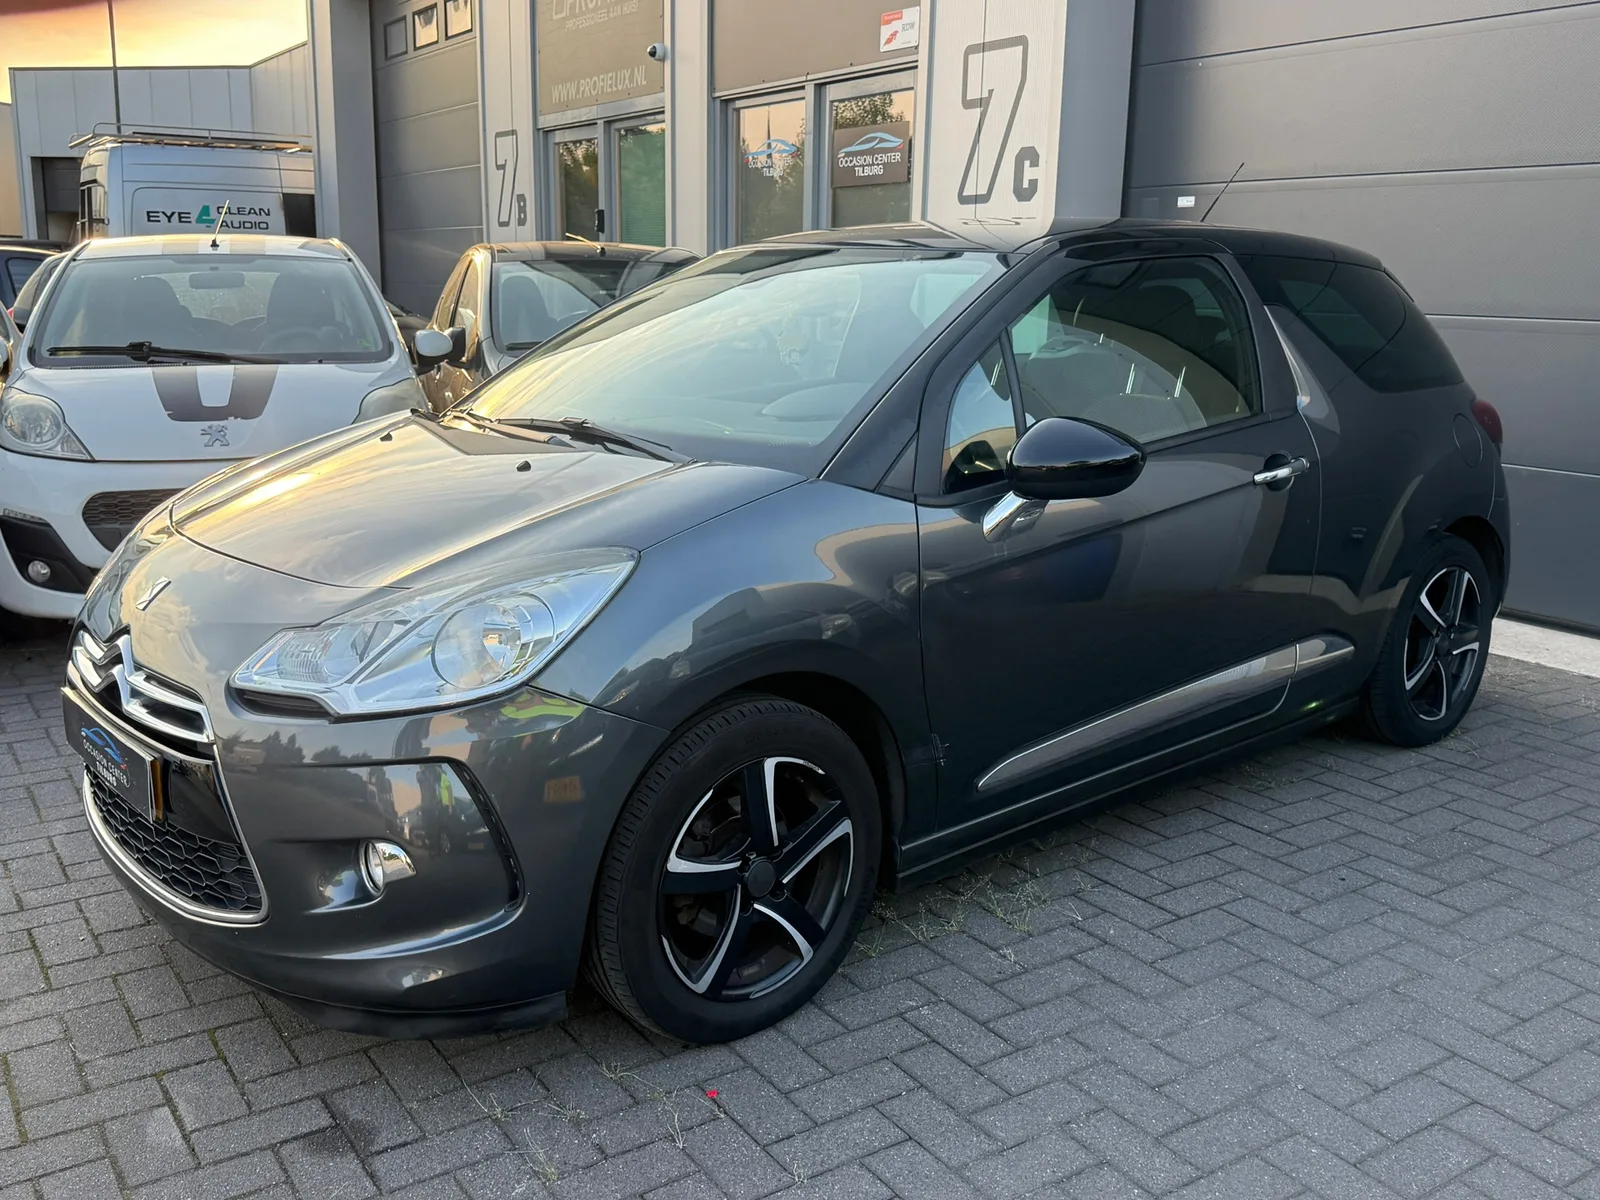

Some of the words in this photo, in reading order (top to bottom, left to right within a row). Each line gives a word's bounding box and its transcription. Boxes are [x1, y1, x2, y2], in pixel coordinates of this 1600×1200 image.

[901, 21, 915, 32] RDW
[551, 65, 647, 104] WWW.PROFIELUX.NL
[957, 34, 1029, 206] 7
[1012, 145, 1040, 203] C
[838, 155, 872, 168] OCCASION
[873, 152, 901, 164] CENTER
[854, 166, 884, 177] TILBURG
[146, 210, 192, 224] EYE
[216, 205, 271, 217] CLEAN
[218, 219, 270, 231] AUDIO
[82, 738, 107, 768] OCCASION
[107, 761, 129, 786] CENTER
